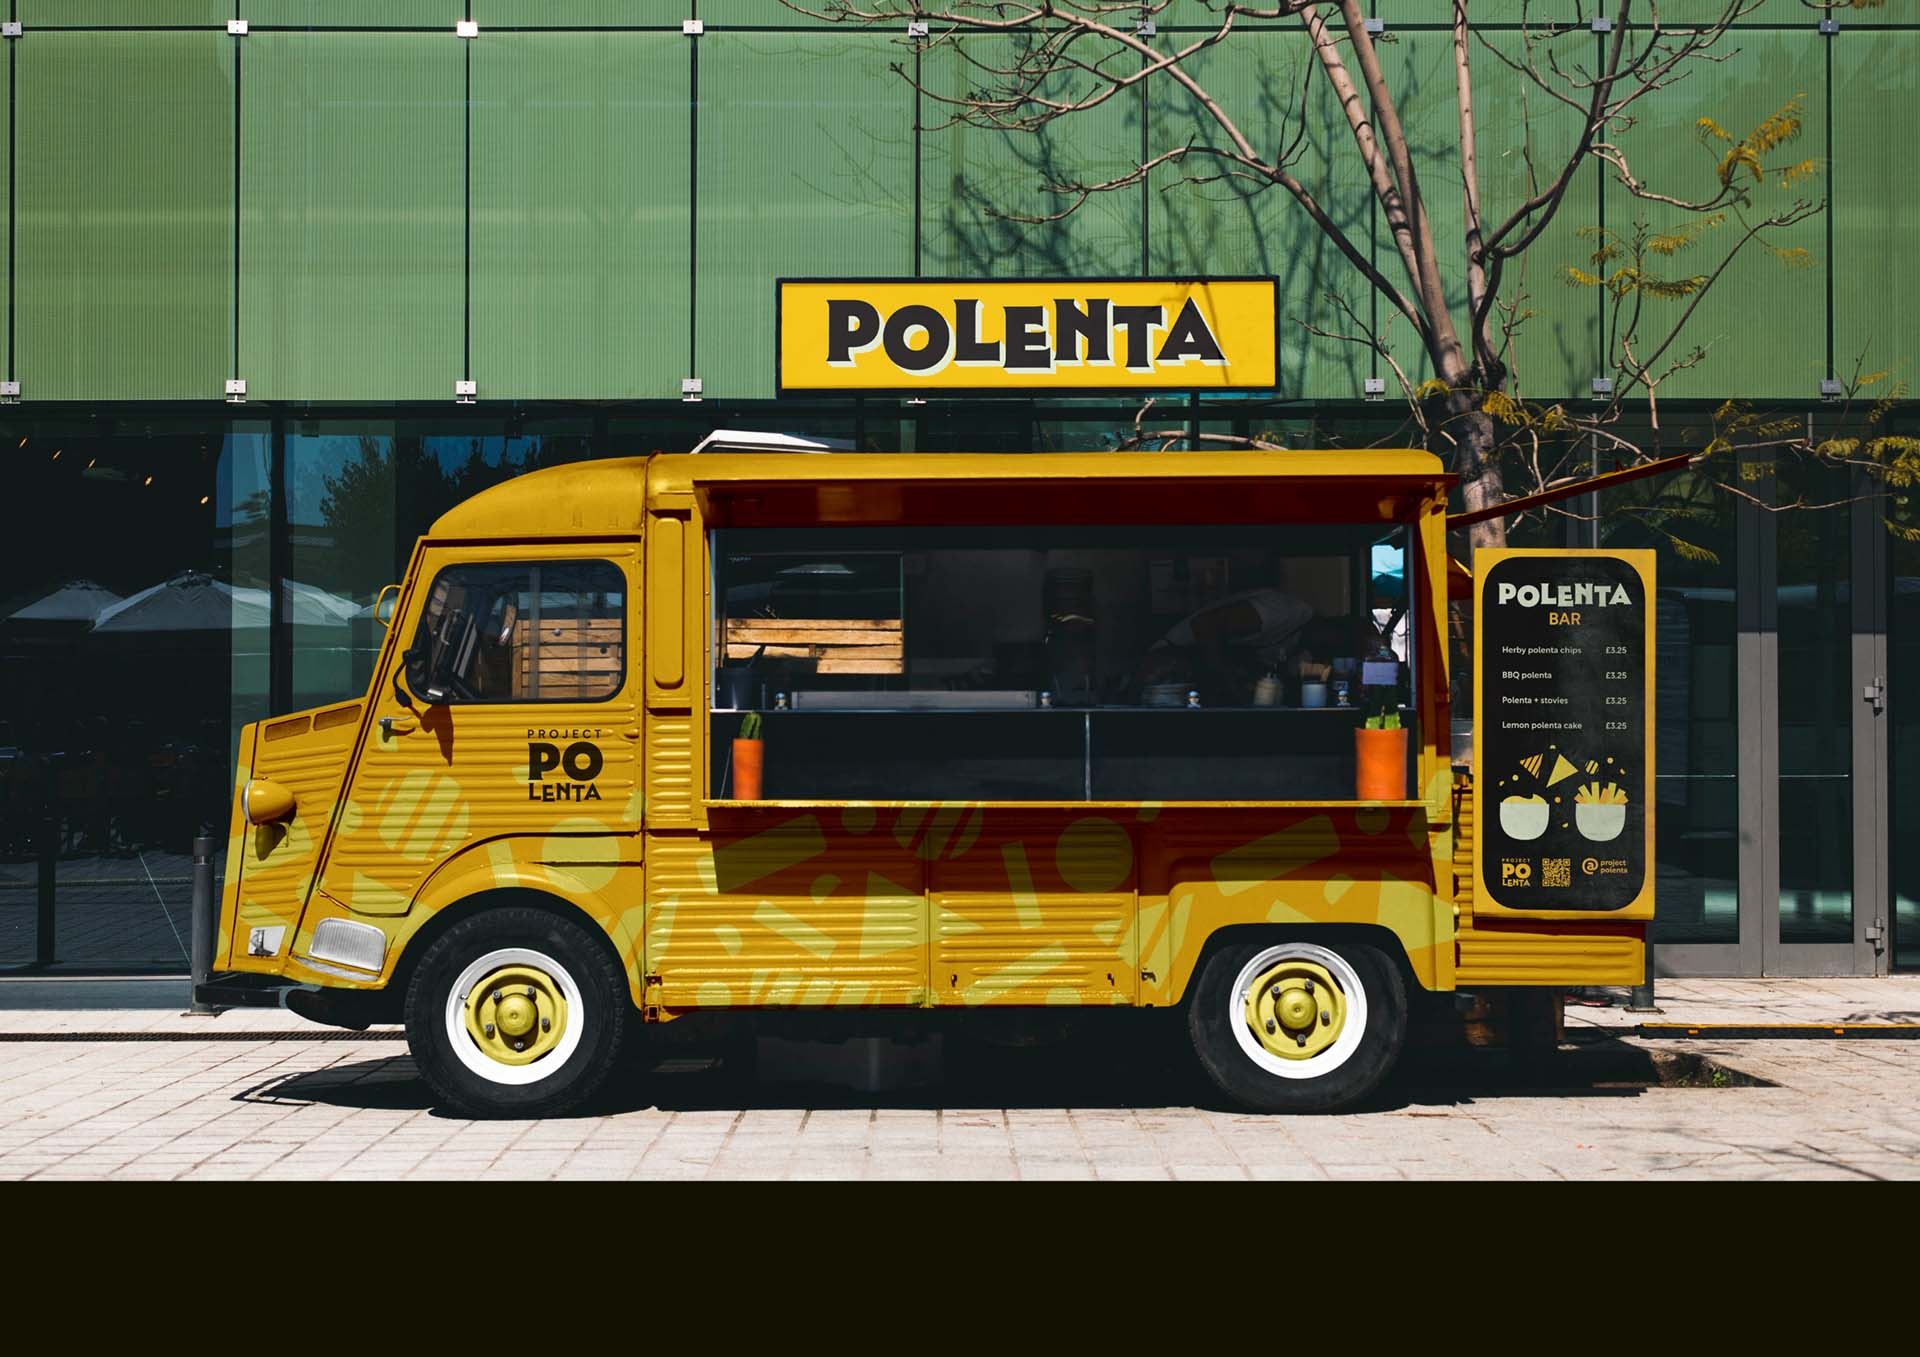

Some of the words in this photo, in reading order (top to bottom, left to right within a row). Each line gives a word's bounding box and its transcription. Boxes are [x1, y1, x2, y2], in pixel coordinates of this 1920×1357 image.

[826, 296, 1229, 376] POLENTA
[1498, 583, 1632, 608] POLENTA
[1549, 612, 1581, 625] BAR
[1502, 646, 1526, 656] Herby
[1528, 646, 1558, 655] polenta
[1560, 646, 1582, 655] chips
[1605, 646, 1627, 654] £3.25
[1502, 671, 1519, 681] BBQ
[1521, 671, 1552, 680] polenta
[1605, 671, 1627, 680] £3.25
[1502, 696, 1532, 704] Polenta
[1540, 696, 1569, 704] stovies
[1605, 696, 1627, 705] £3.25
[1502, 721, 1530, 729] Lemon
[1531, 721, 1562, 731] polenta
[1563, 721, 1583, 730] cake
[1605, 721, 1627, 730] £3.25
[527, 729, 602, 739] PROJECT
[528, 741, 603, 781] PO
[528, 782, 602, 803] LENTA
[1502, 863, 1532, 879] PO
[1502, 879, 1531, 888] LENTA
